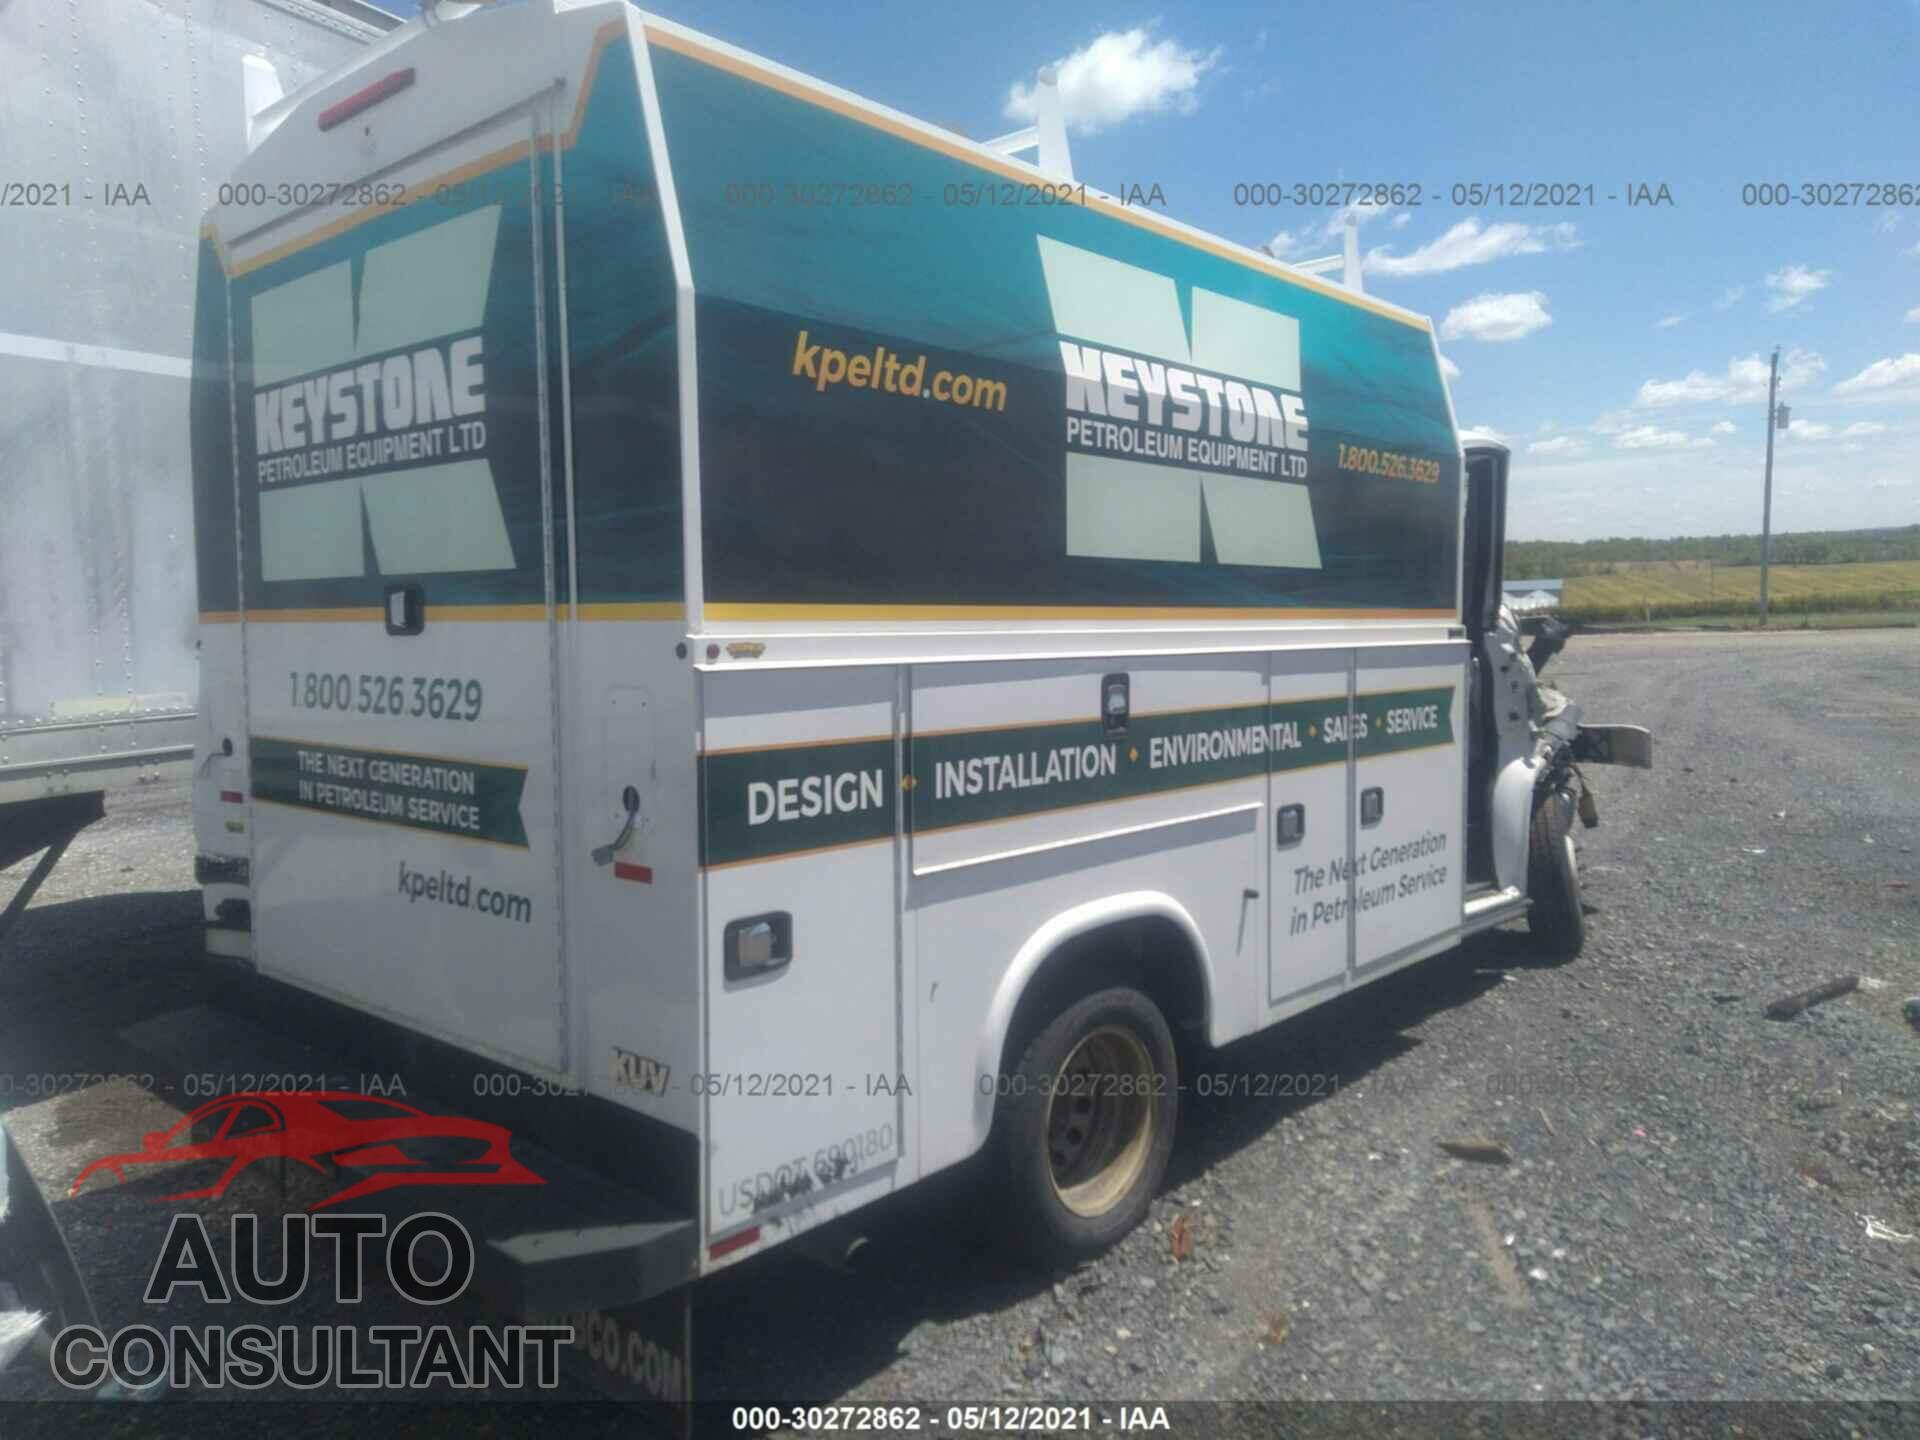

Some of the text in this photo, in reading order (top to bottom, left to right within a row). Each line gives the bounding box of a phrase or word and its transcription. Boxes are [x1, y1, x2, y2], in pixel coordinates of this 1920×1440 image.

[255, 336, 486, 455] KEYSTONE
[792, 330, 1008, 412] kpeltd.com
[1059, 341, 1309, 452] KEYSTONE
[258, 421, 487, 484] PETROLEUM EQUIPMENT LTD
[1067, 416, 1308, 478] PETROLEUM EQUIPMENT LTD
[298, 750, 475, 796] THE NEXT GENERATION
[747, 705, 1438, 826] DESIGN INSTALLATION ENVIRONMENTAL SALES SERVICE
[299, 779, 481, 830] IN PETROLEUM SERVICE
[398, 861, 531, 923] kpeltd.com
[1294, 829, 1447, 895] The Next Generation
[1290, 906, 1308, 937] in
[1397, 863, 1447, 899] Service
[609, 1046, 671, 1097] KUV
